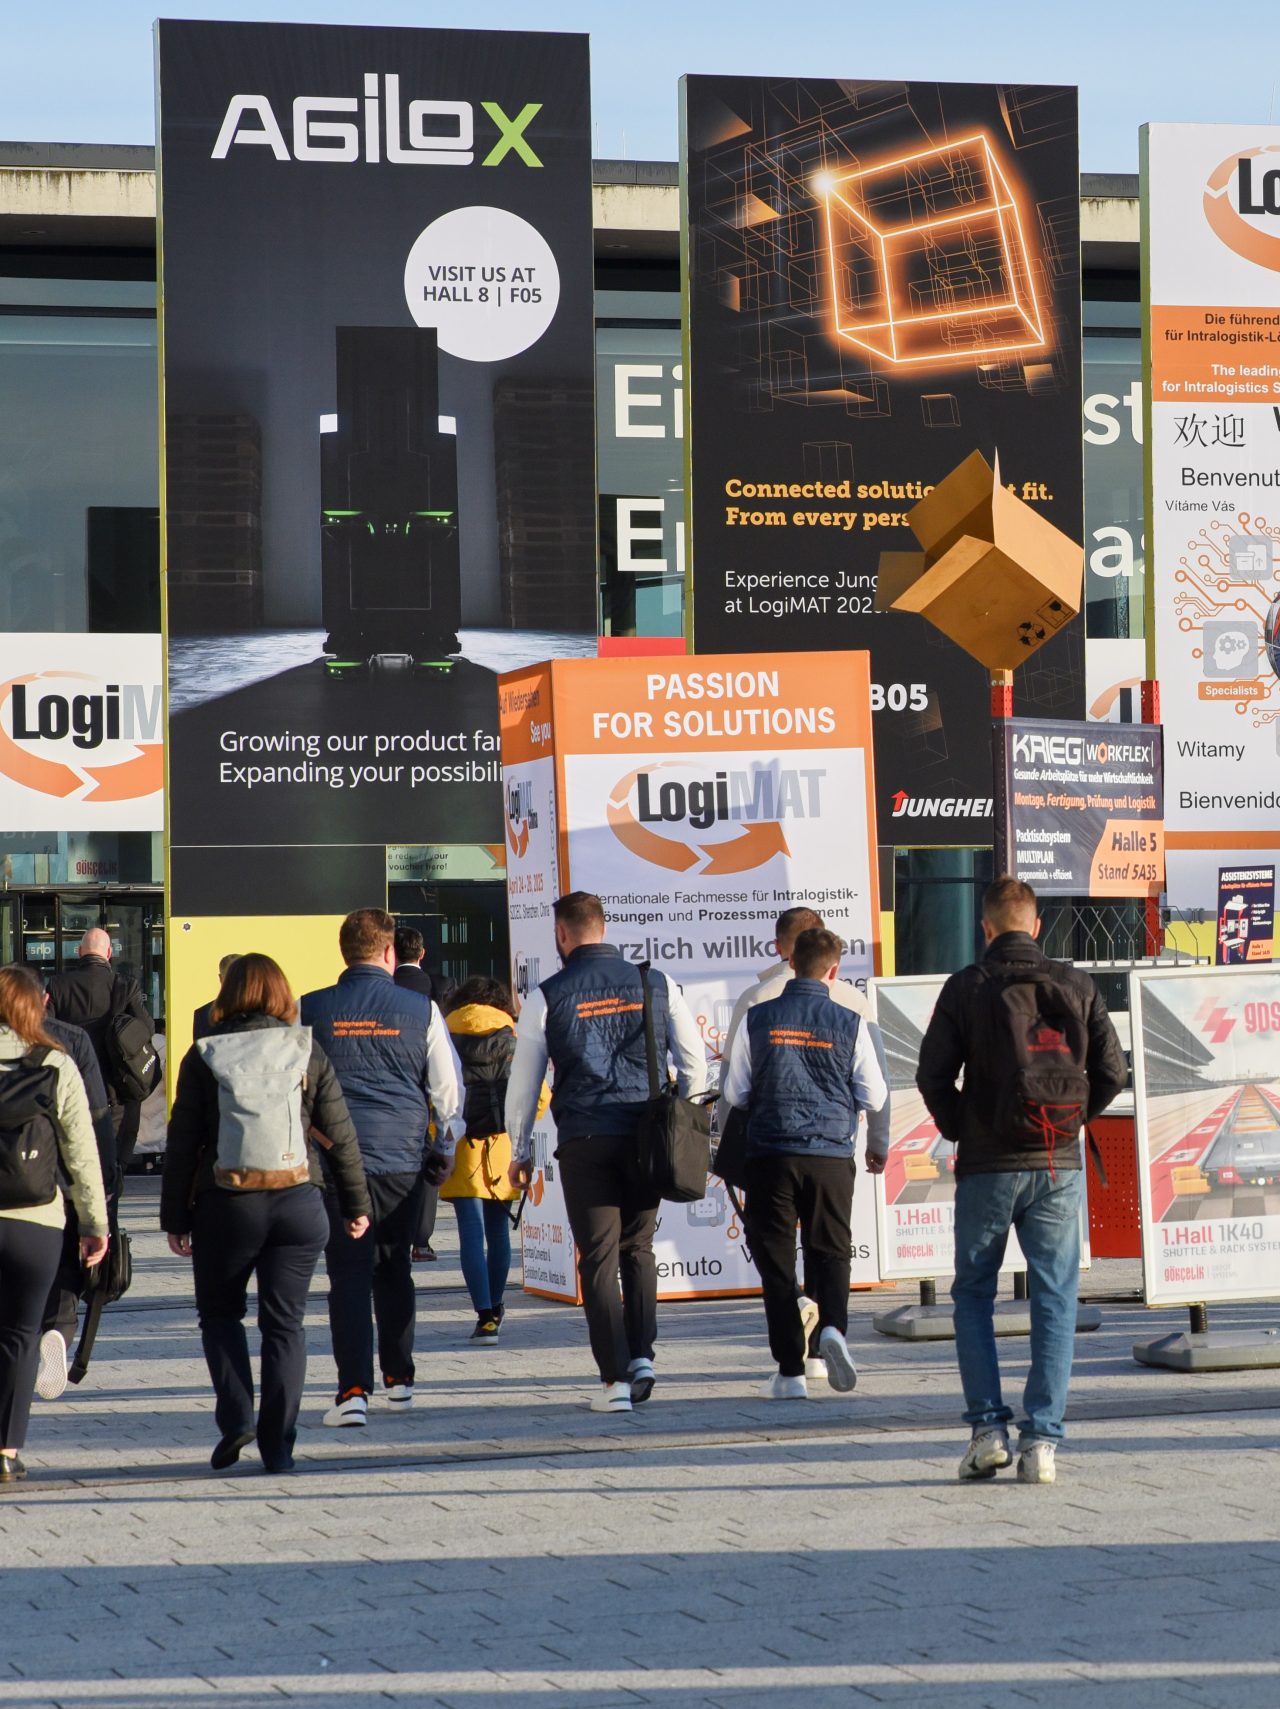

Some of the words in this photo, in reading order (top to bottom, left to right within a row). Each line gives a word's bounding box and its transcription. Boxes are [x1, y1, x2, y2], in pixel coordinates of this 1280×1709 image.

[428, 265, 477, 283] VISIT
[481, 266, 506, 284] US
[510, 267, 536, 284] AT
[423, 285, 474, 303] HALL
[478, 285, 490, 303] 8
[510, 286, 542, 304] F05
[1205, 313, 1226, 326] Die
[1165, 329, 1185, 342] für
[1211, 364, 1235, 377] The
[1162, 381, 1180, 393] for
[1184, 381, 1269, 397] Intralogistics
[1083, 381, 1144, 446] st
[1173, 412, 1247, 448] 欢迎
[725, 478, 851, 500] Connected
[857, 480, 936, 500] solutio
[1022, 481, 1054, 500] fit.
[1212, 500, 1236, 513] Vás
[725, 507, 785, 527] From
[793, 510, 856, 530] every
[725, 571, 830, 593] Experience
[725, 598, 742, 614] at
[748, 597, 831, 618] LogiMAT
[647, 671, 779, 700] PASSION
[1205, 685, 1258, 698] Specialists
[593, 712, 654, 739] FOR
[663, 707, 836, 738] SOLUTIONS
[220, 731, 321, 758] Growing
[327, 734, 368, 752] our
[374, 731, 468, 758] product
[1013, 734, 1082, 765] KRIEG
[1086, 742, 1149, 764] WORKFLEX
[1177, 741, 1246, 762] Witamy
[220, 761, 344, 788] Expanding
[350, 766, 404, 788] your
[1014, 768, 1040, 780] Gesunde
[637, 769, 827, 829] LogiMAT
[892, 797, 994, 818] JUNGHEI
[1014, 792, 1046, 809] Montage,
[1047, 792, 1086, 810] Fertigung,
[1087, 794, 1114, 811] Prüfung
[1114, 796, 1127, 809] und
[1128, 796, 1156, 812] Logistik
[1016, 829, 1071, 847] Packtischsystem
[1112, 832, 1147, 852] Halle
[1150, 832, 1157, 852] 5
[1017, 850, 1054, 864] MULTIPLAN
[1098, 863, 1130, 880] Stand
[1131, 863, 1157, 881] 5A35
[595, 890, 669, 905] ternationale
[674, 891, 748, 904] Fachmesse
[752, 890, 770, 903] für
[773, 888, 859, 903] Intralogistik-
[604, 909, 664, 925] ösungen
[669, 909, 693, 922] und
[619, 936, 694, 962] rzlich
[895, 1208, 941, 1226] 1.Hall
[1161, 1225, 1214, 1247] 1.Hall
[1218, 1222, 1264, 1243] 1K40
[1163, 1247, 1207, 1258] SHUTTLE
[1210, 1246, 1217, 1256] &
[1220, 1243, 1246, 1255] RACK
